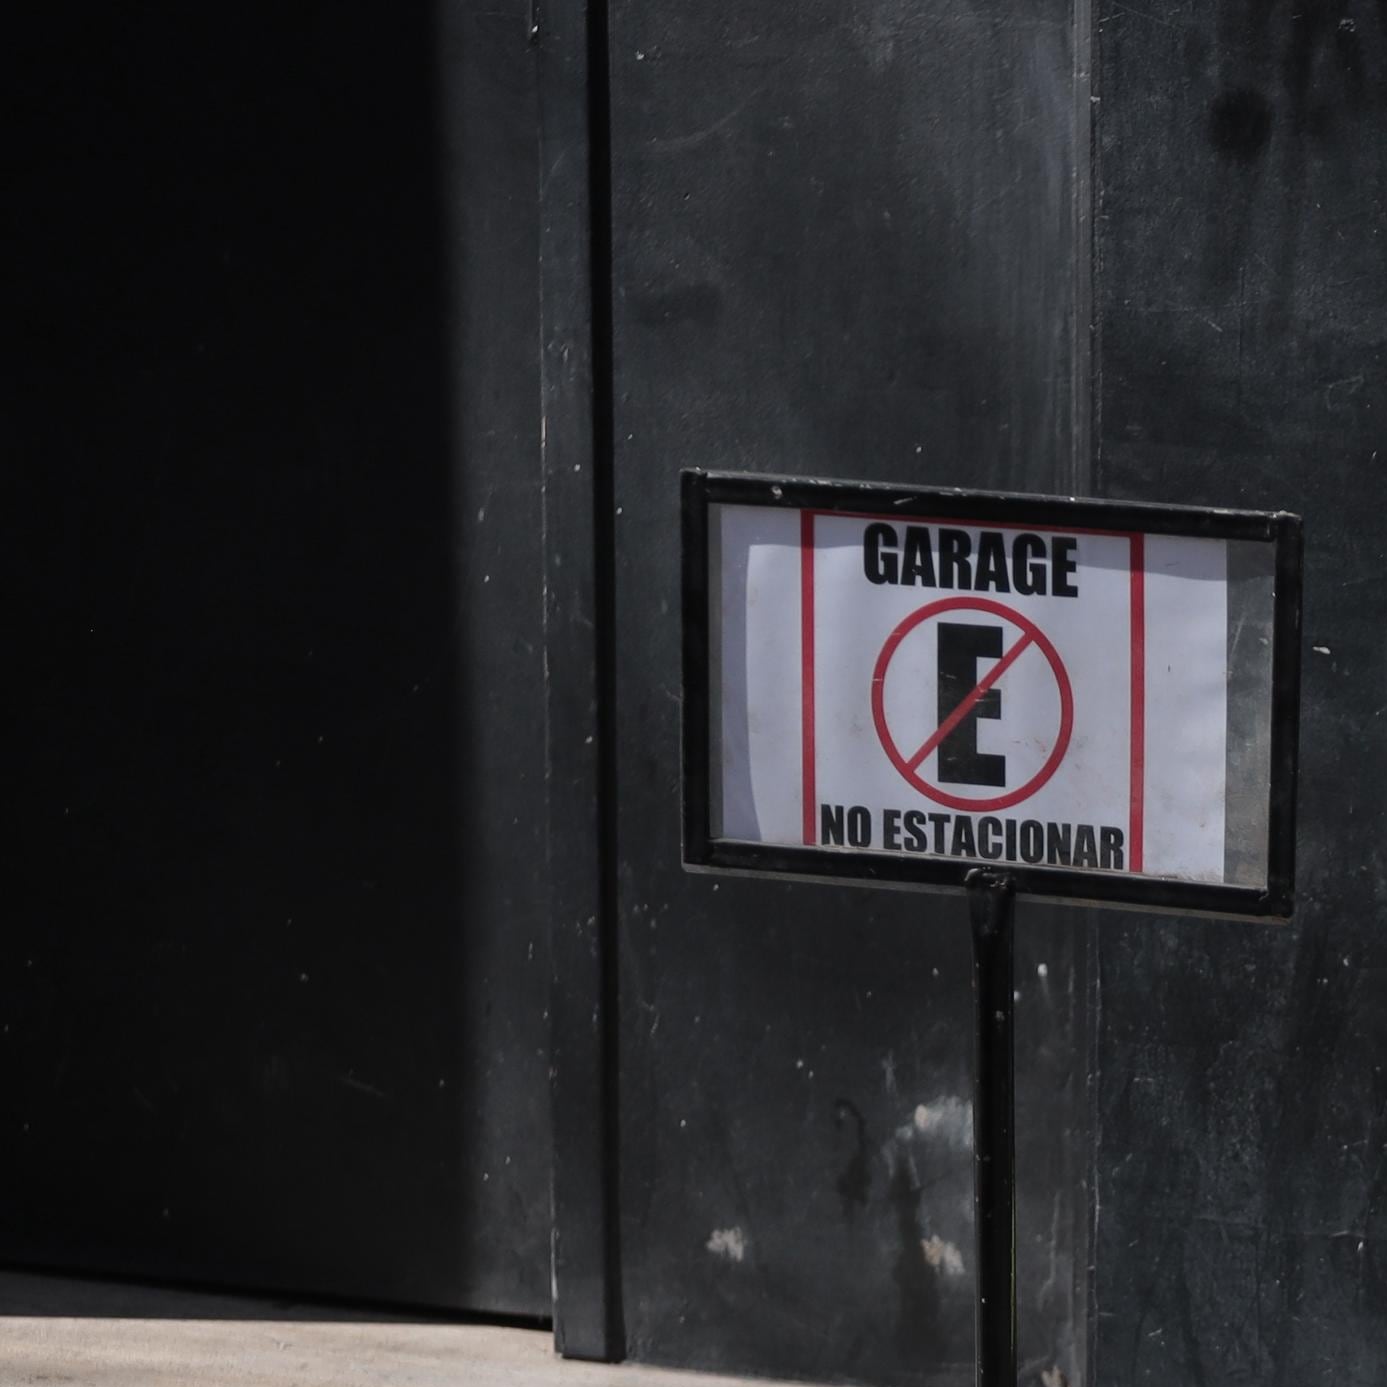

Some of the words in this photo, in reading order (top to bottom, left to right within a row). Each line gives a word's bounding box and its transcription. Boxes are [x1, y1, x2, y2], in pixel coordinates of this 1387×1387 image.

[863, 522, 1079, 599] GARAGE
[937, 621, 1006, 788] E
[820, 803, 873, 848] NO
[882, 809, 1125, 870] ESTACIONAR
